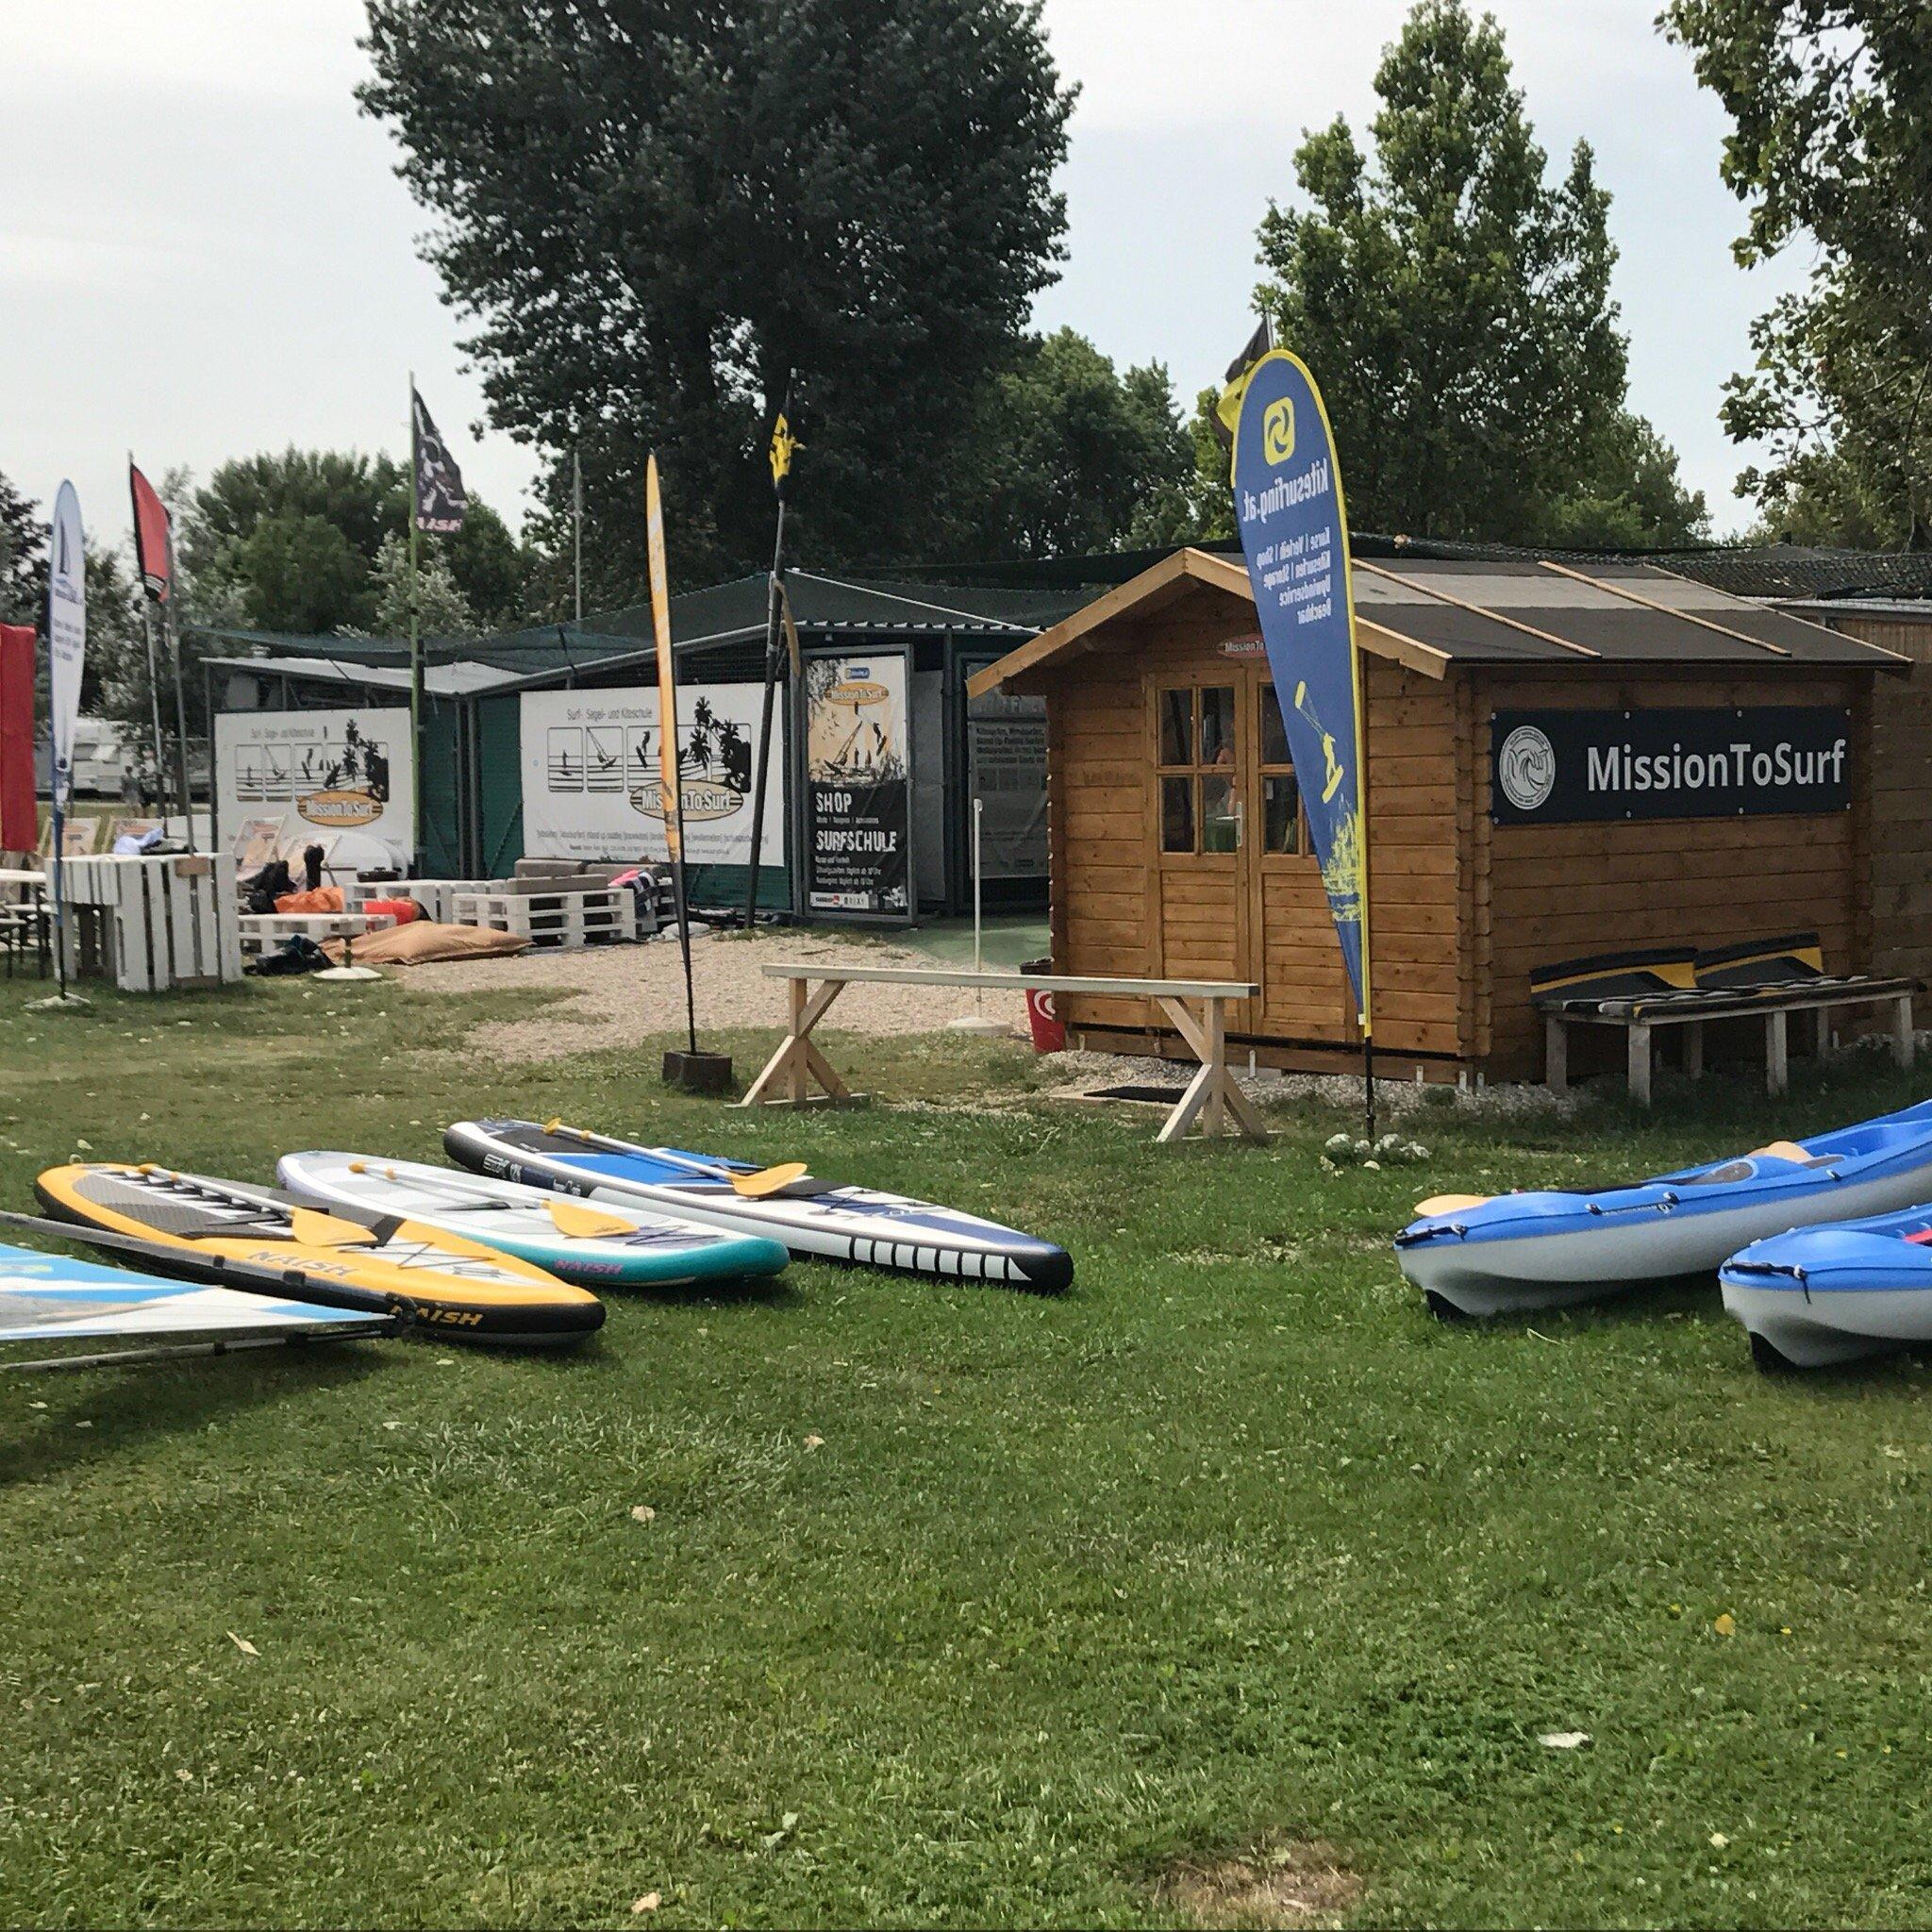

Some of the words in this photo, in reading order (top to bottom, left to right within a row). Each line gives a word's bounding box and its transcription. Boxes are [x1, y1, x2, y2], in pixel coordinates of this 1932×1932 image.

[1587, 739, 1846, 791] MissionToSurf
[815, 791, 853, 813] SHOP
[816, 830, 897, 852] SURFSCHULE
[247, 1250, 359, 1278] NAISH
[554, 1259, 623, 1274] NAISH
